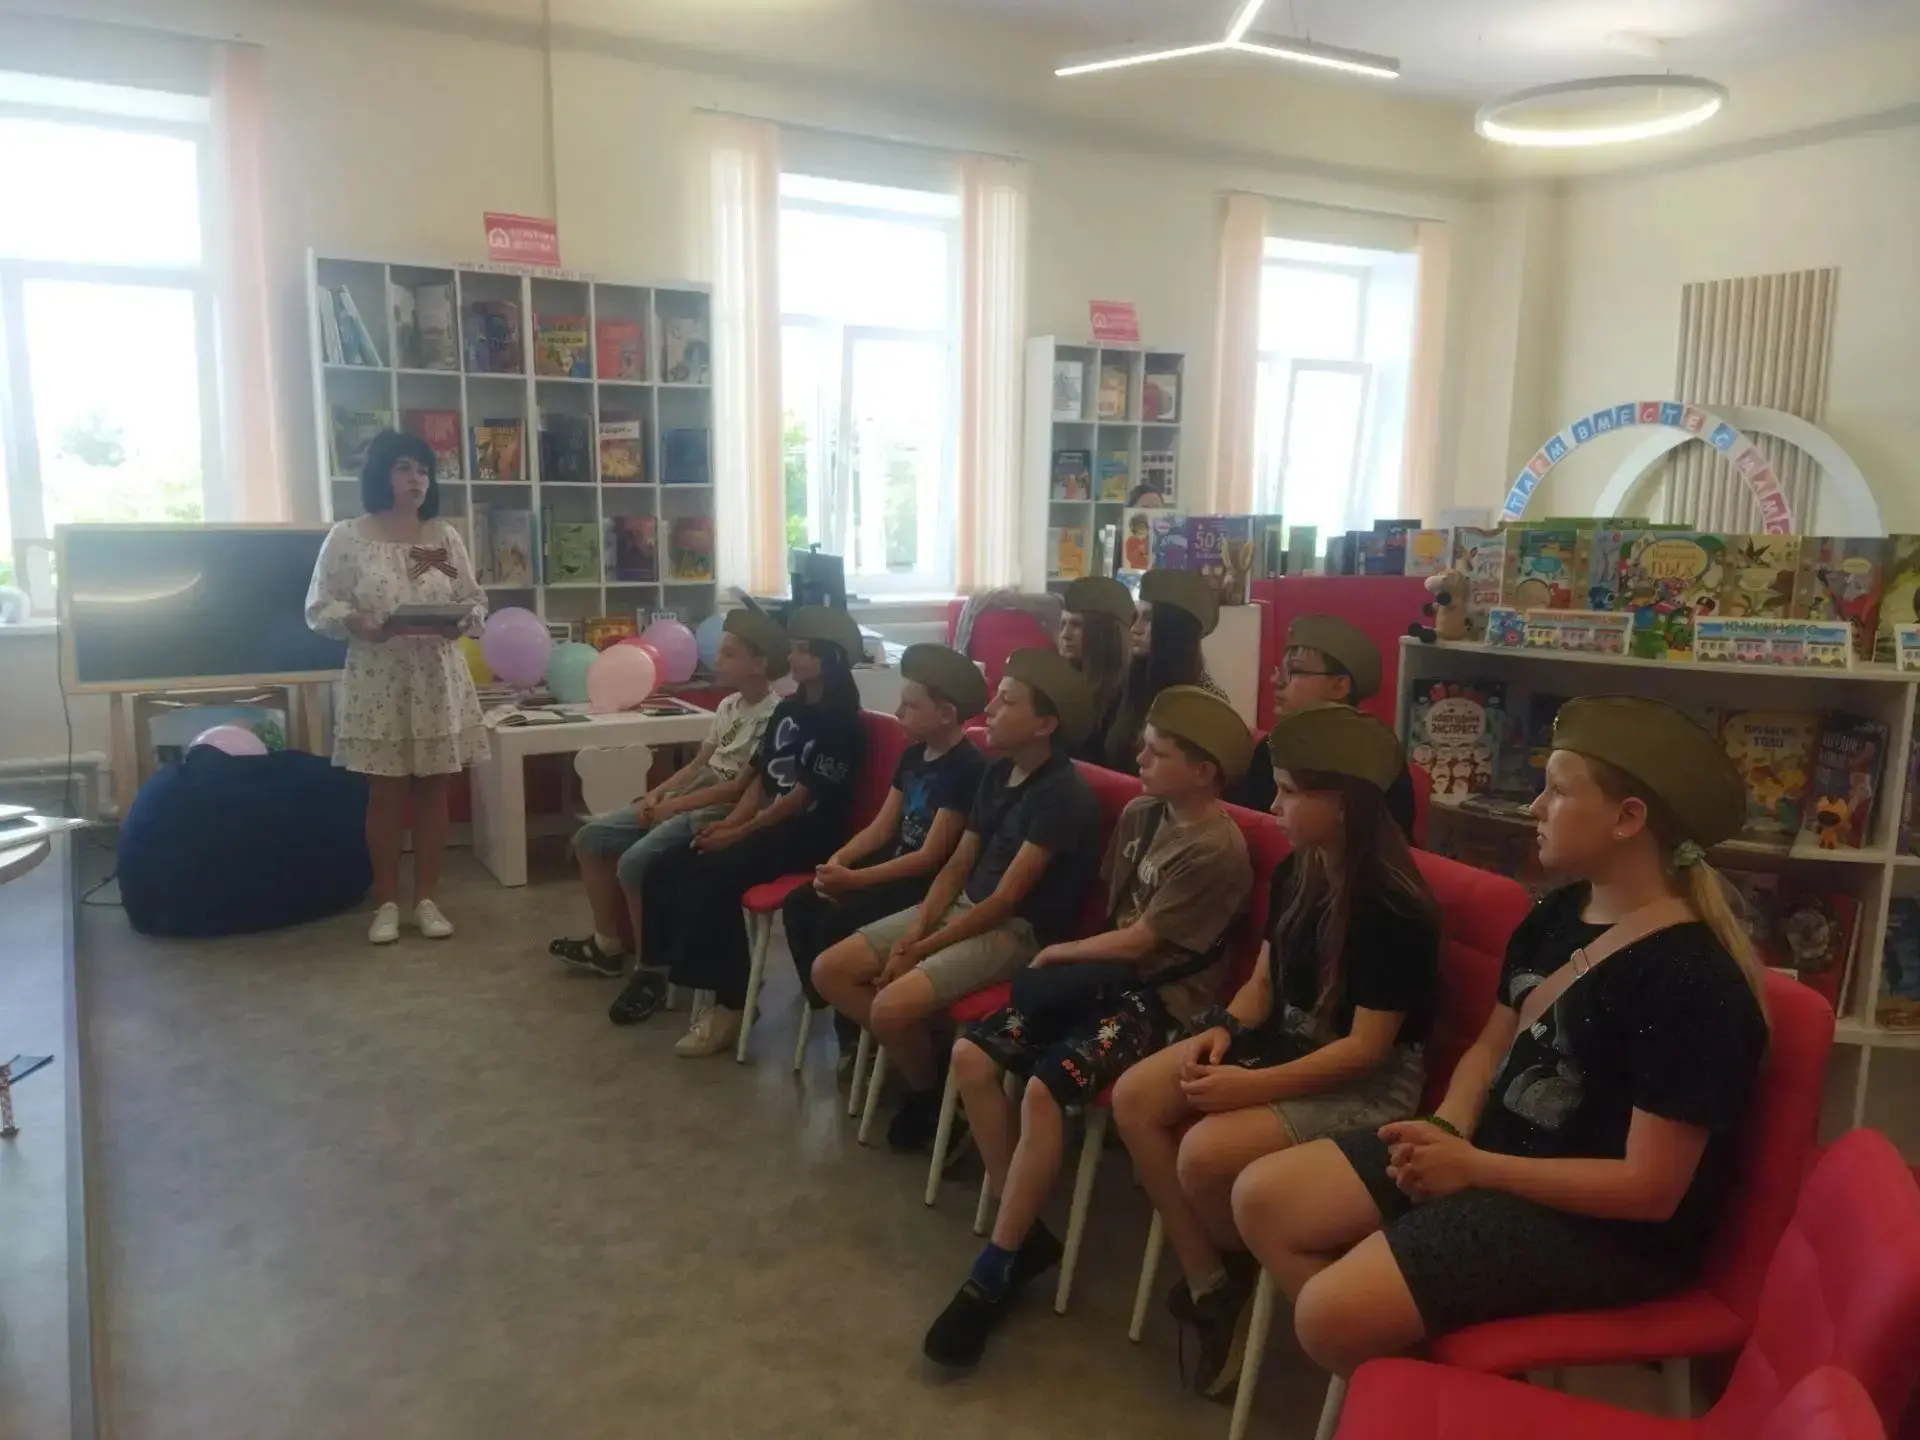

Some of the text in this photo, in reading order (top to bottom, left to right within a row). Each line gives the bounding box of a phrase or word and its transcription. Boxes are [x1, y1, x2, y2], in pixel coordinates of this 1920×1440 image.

[1509, 442, 1565, 509] ТАЕМ
[1577, 406, 1700, 440] ВМЕСТЕ
[1714, 431, 1730, 448] С
[1431, 723, 1481, 735] ЭКСПРЕСС
